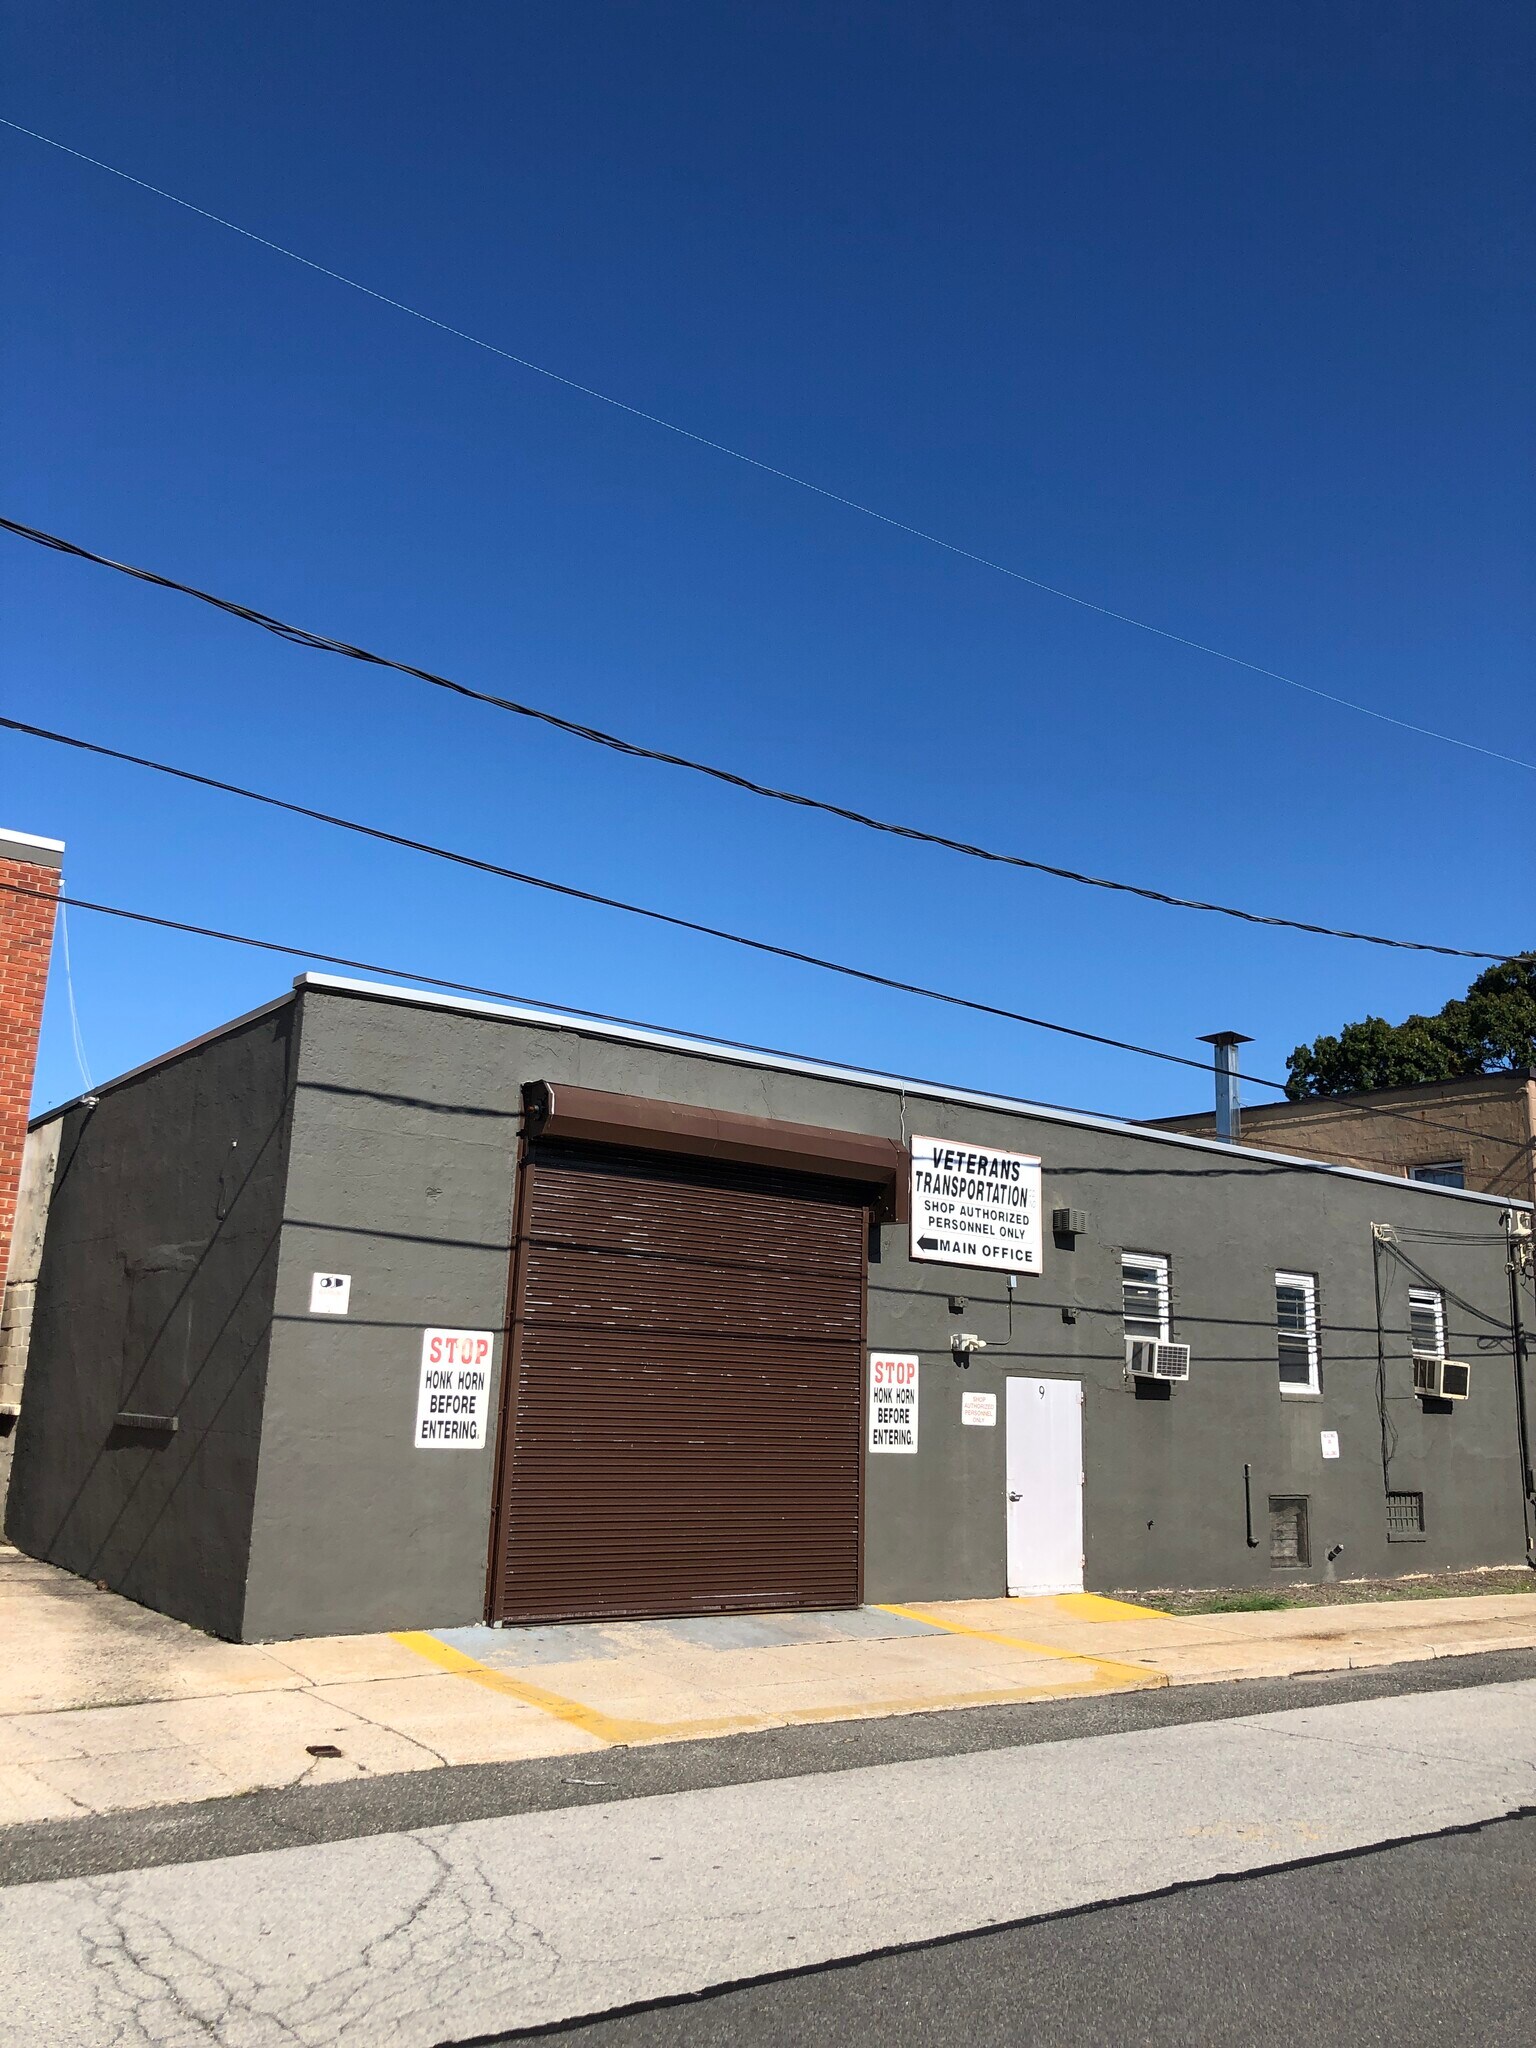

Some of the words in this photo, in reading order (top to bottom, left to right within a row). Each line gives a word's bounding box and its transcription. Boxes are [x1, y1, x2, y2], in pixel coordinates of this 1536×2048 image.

[933, 1147, 1021, 1181] VETERANS
[915, 1170, 1028, 1208] TRANSPORTATION
[924, 1199, 955, 1214] SHOP
[960, 1205, 1030, 1226] AUTHORIZED
[928, 1215, 995, 1236] PERSONNEL
[999, 1226, 1026, 1240] ONLY
[939, 1239, 976, 1255] MAIN
[982, 1244, 1033, 1262] OFFICE
[429, 1336, 489, 1365] STOP
[425, 1370, 453, 1389] HONK
[457, 1371, 485, 1390] HORN
[874, 1361, 915, 1384] STOP
[429, 1394, 477, 1414] BEFORE
[873, 1387, 893, 1403] HONK
[896, 1388, 915, 1405] HORN
[1038, 1385, 1045, 1400] 9
[878, 1407, 910, 1424] BEFORE
